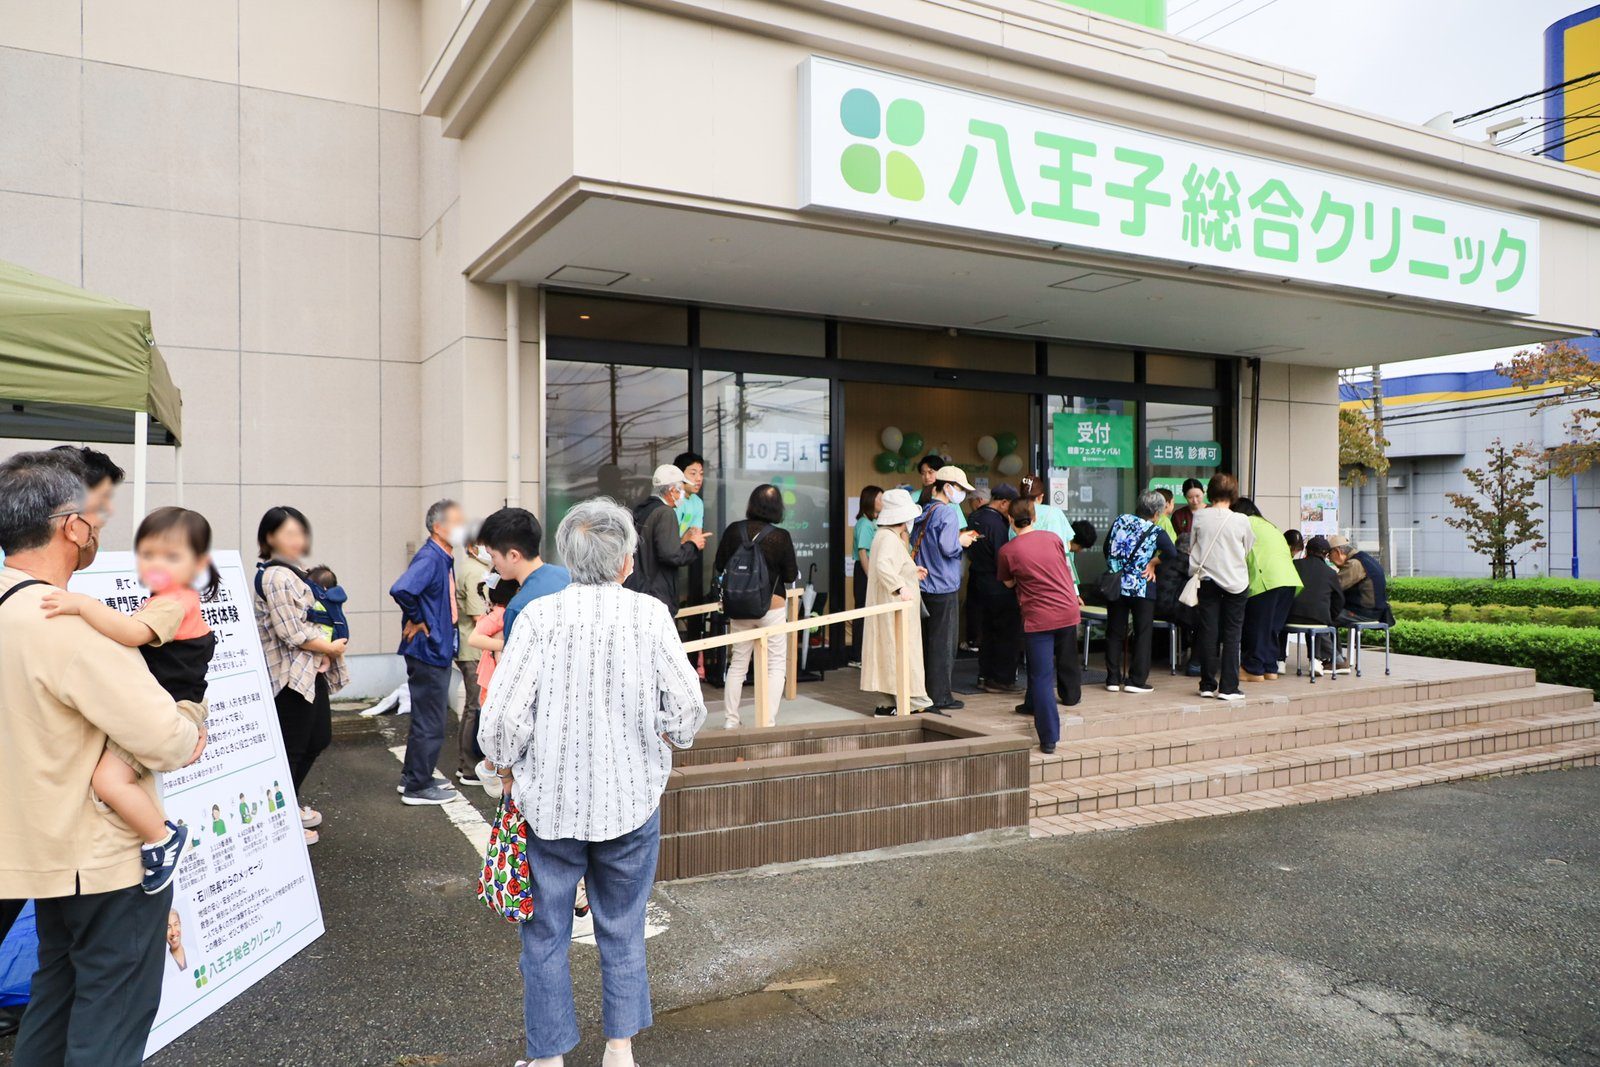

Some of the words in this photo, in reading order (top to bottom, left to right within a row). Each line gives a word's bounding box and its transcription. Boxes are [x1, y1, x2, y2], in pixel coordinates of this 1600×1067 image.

[948, 119, 1528, 293] 八王子総合クリニック
[1077, 421, 1111, 444] 受付
[1154, 445, 1184, 459] 土日祝
[1188, 446, 1217, 460] 診療可
[209, 921, 282, 978] 八王子総合クリニック
